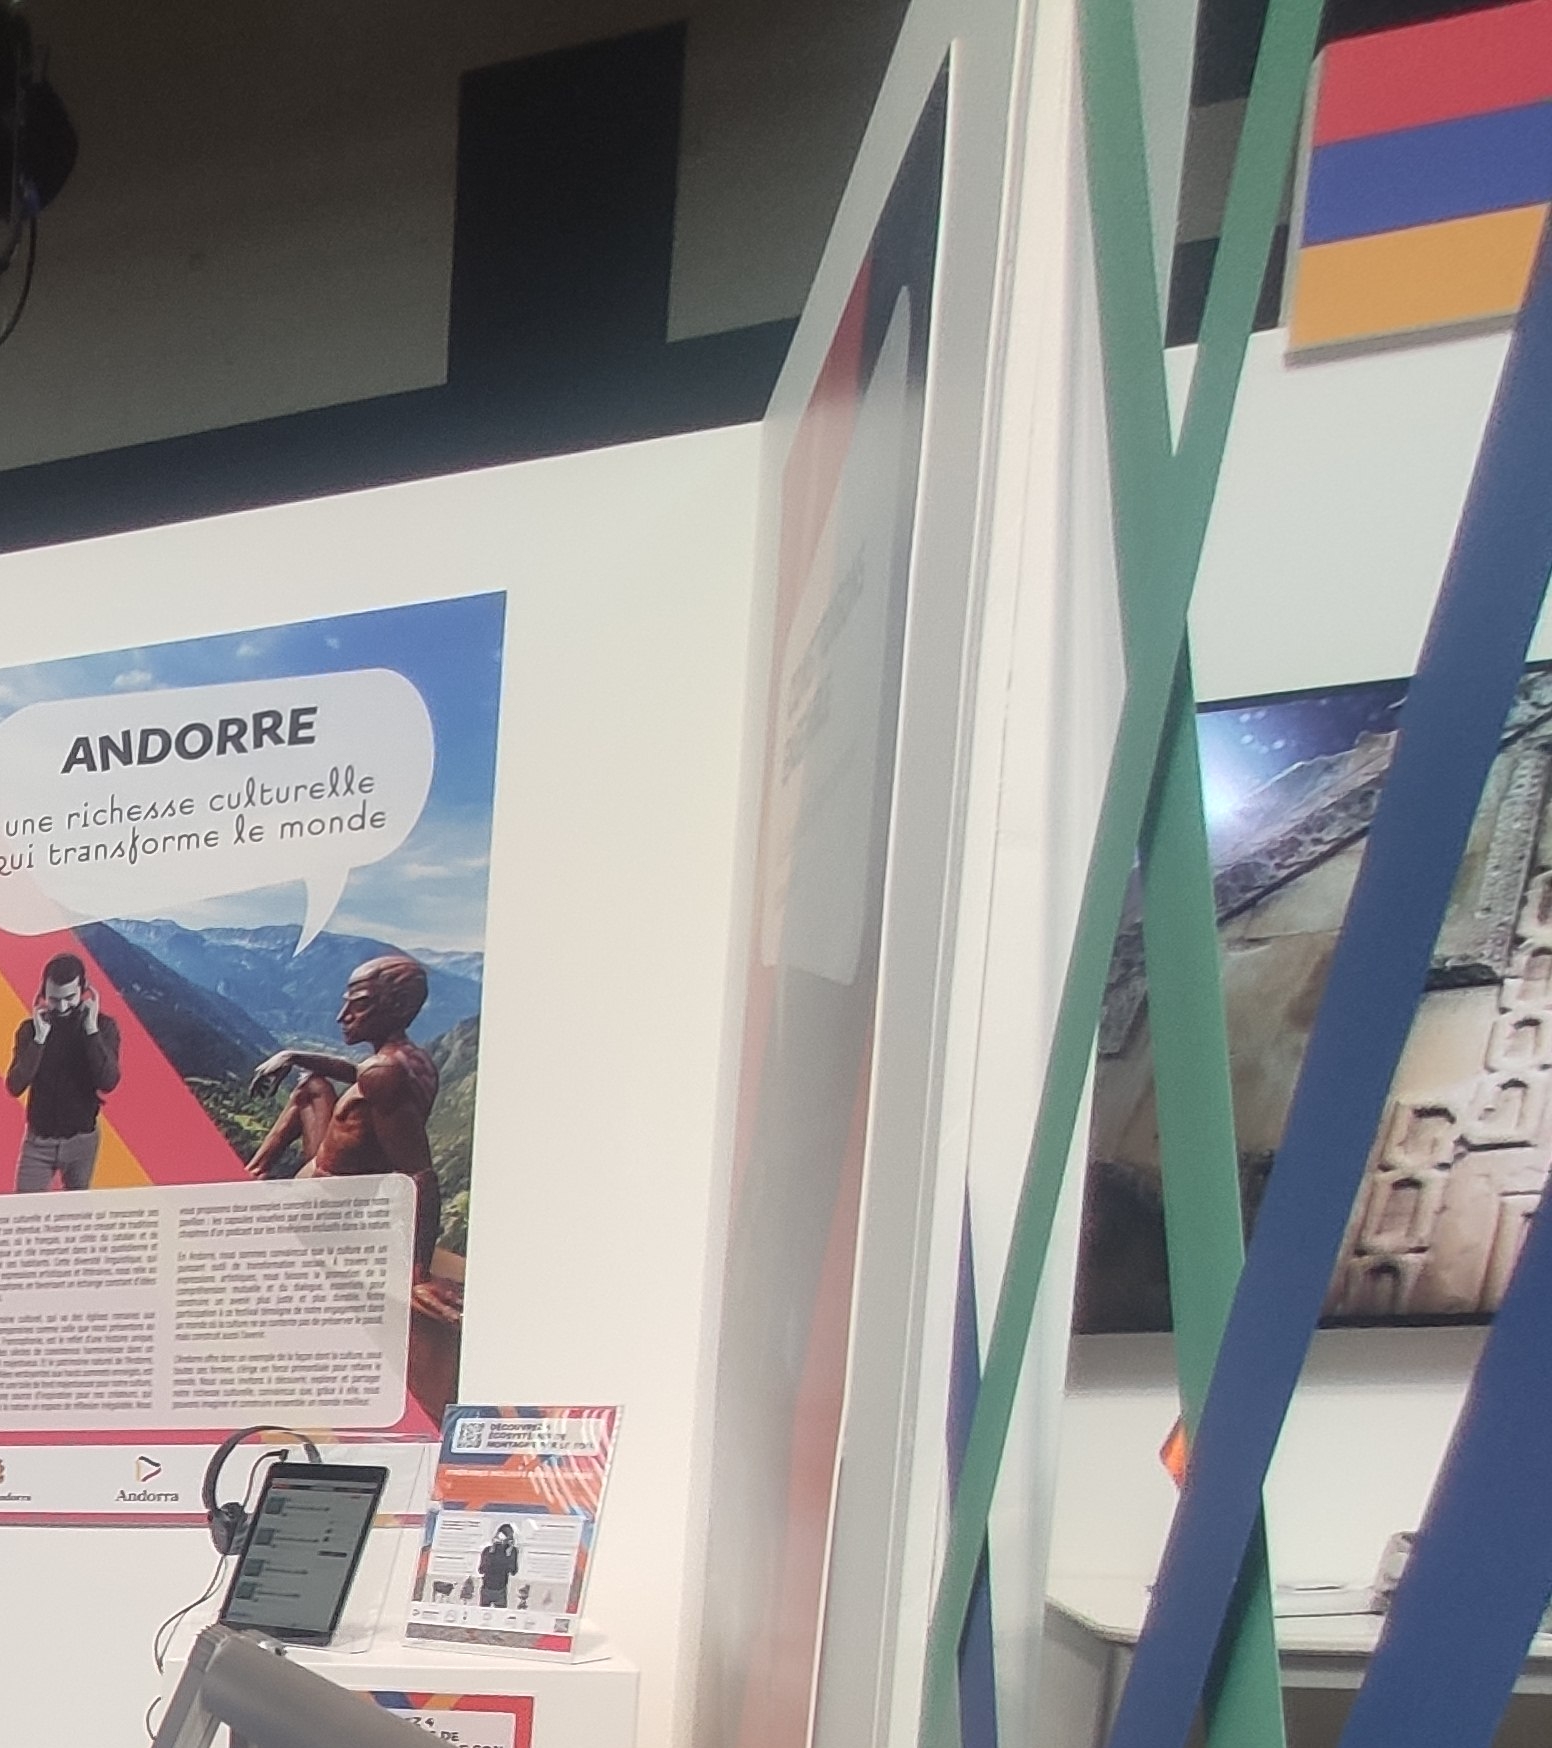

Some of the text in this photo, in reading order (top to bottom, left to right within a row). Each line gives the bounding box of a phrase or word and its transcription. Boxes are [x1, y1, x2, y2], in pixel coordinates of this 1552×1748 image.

[60, 705, 318, 774] ANDORRE
[5, 764, 375, 836] une richesse culturelle
[49, 826, 219, 865] transforme
[233, 813, 265, 843] le
[280, 800, 387, 840] monde
[114, 1489, 180, 1502] Andorra
[440, 1731, 459, 1742] DE
